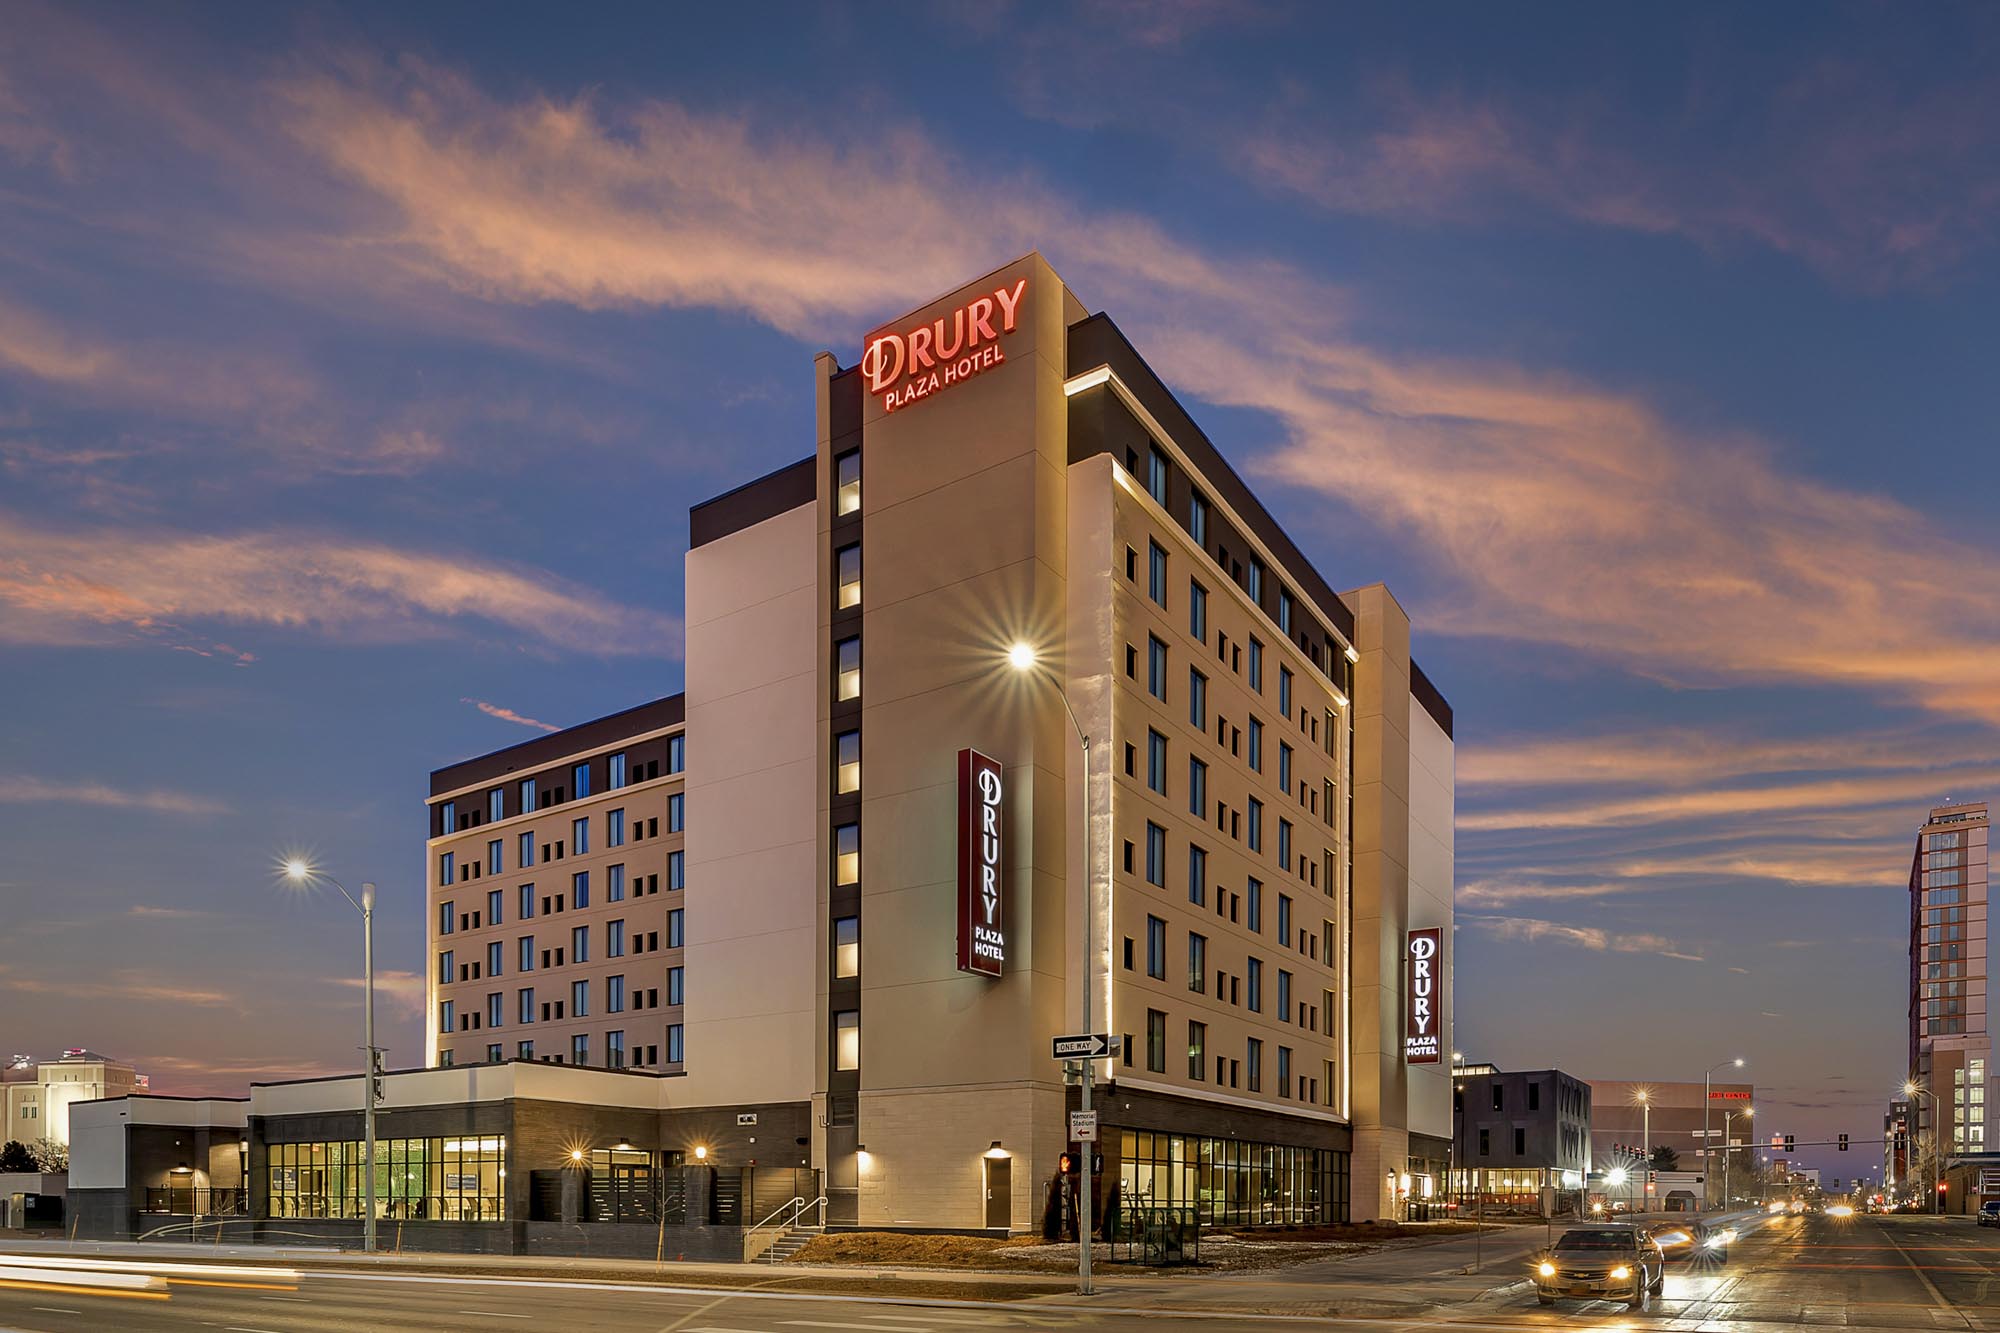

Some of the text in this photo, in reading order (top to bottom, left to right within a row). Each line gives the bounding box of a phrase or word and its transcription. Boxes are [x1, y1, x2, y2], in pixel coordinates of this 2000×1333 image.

[862, 279, 1026, 392] DRURY
[885, 345, 1004, 411] PLAZA HOTEL
[978, 768, 1002, 924] DRURY
[975, 926, 1004, 946] PLAZA
[975, 942, 1004, 960] HOTEL
[1410, 937, 1435, 1034] DRURY
[1060, 1042, 1091, 1051] ONE WAY
[1406, 1046, 1437, 1056] HOTEL
[1407, 1036, 1437, 1046] PLAZA
